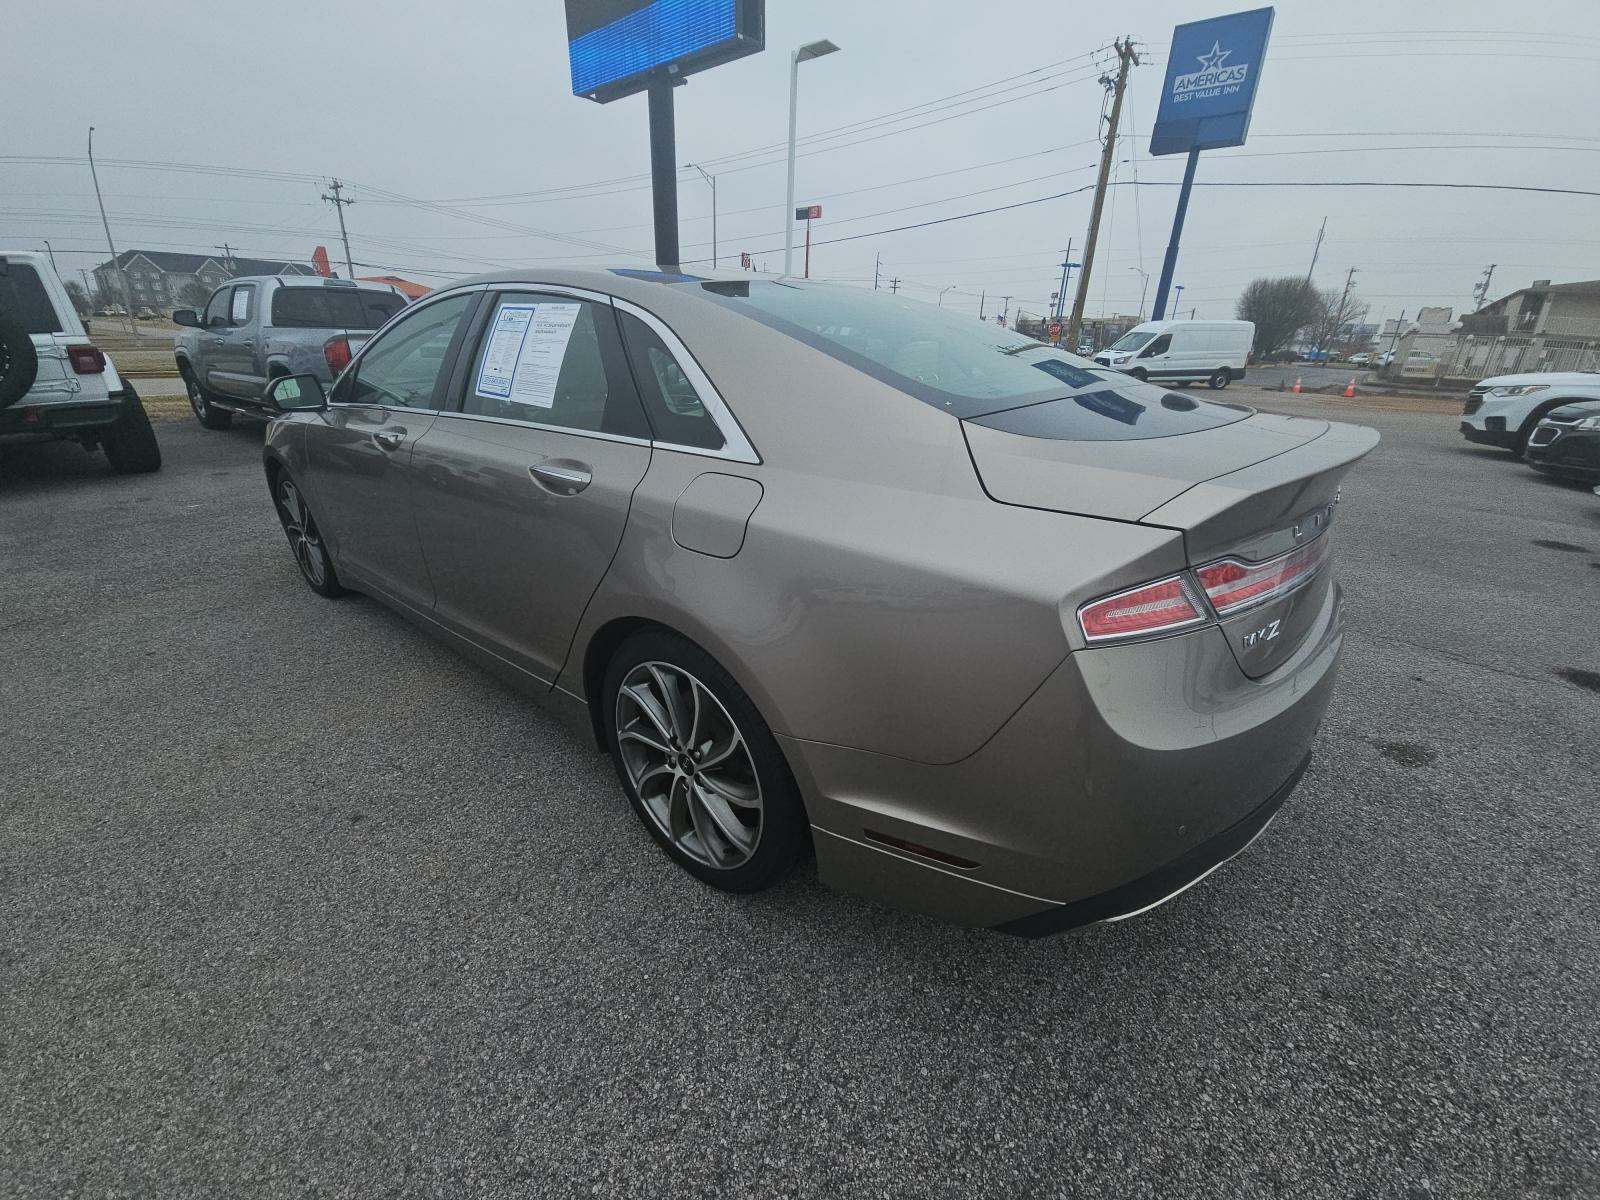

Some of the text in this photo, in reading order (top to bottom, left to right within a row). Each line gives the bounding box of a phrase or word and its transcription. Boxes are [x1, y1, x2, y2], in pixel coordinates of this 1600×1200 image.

[1175, 68, 1245, 90] AMERICAS
[1174, 85, 1240, 103] BEST VALUE INN
